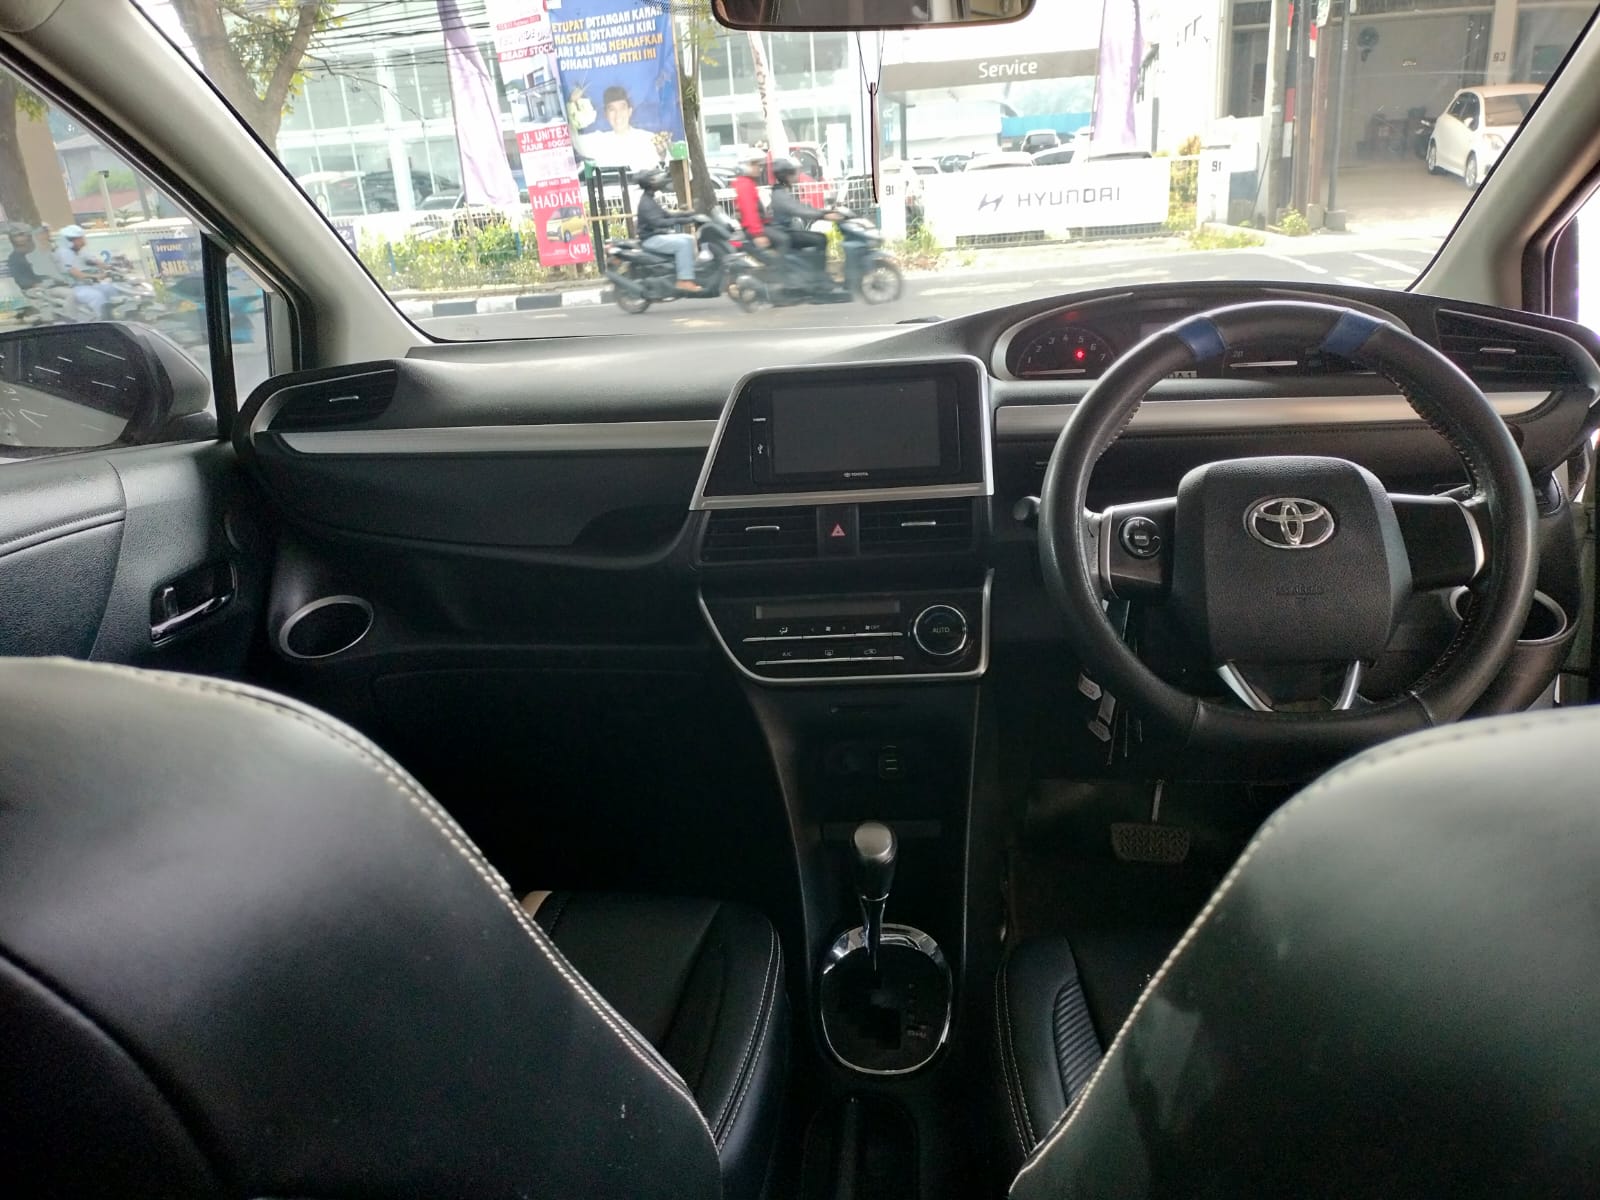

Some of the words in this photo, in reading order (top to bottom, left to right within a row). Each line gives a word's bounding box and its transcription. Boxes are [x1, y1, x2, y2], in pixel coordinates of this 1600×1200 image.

[552, 19, 585, 32] ETUPAT
[586, 10, 631, 28] DITANGAN
[555, 32, 589, 45] NASTAR
[591, 24, 635, 41] DITANGAN
[637, 20, 656, 33] KIRI
[501, 48, 529, 61] READY
[530, 44, 554, 56] STOCK
[555, 45, 573, 58] ARI
[575, 42, 607, 56] SALING
[609, 33, 663, 52] MEMAAFKAN
[560, 58, 592, 71] DIHARI
[594, 53, 617, 68] YANG
[619, 50, 641, 63] FITRI
[643, 48, 656, 60] INI
[978, 59, 1038, 79] Service
[535, 126, 569, 142] UNITEX
[521, 142, 543, 152] TAJUR
[1211, 160, 1222, 172] 91
[533, 190, 582, 209] HADIAH
[885, 185, 895, 196] 91
[1018, 186, 1120, 208] HYUNDAI
[1078, 335, 1085, 343] 5
[1090, 343, 1097, 351] 6
